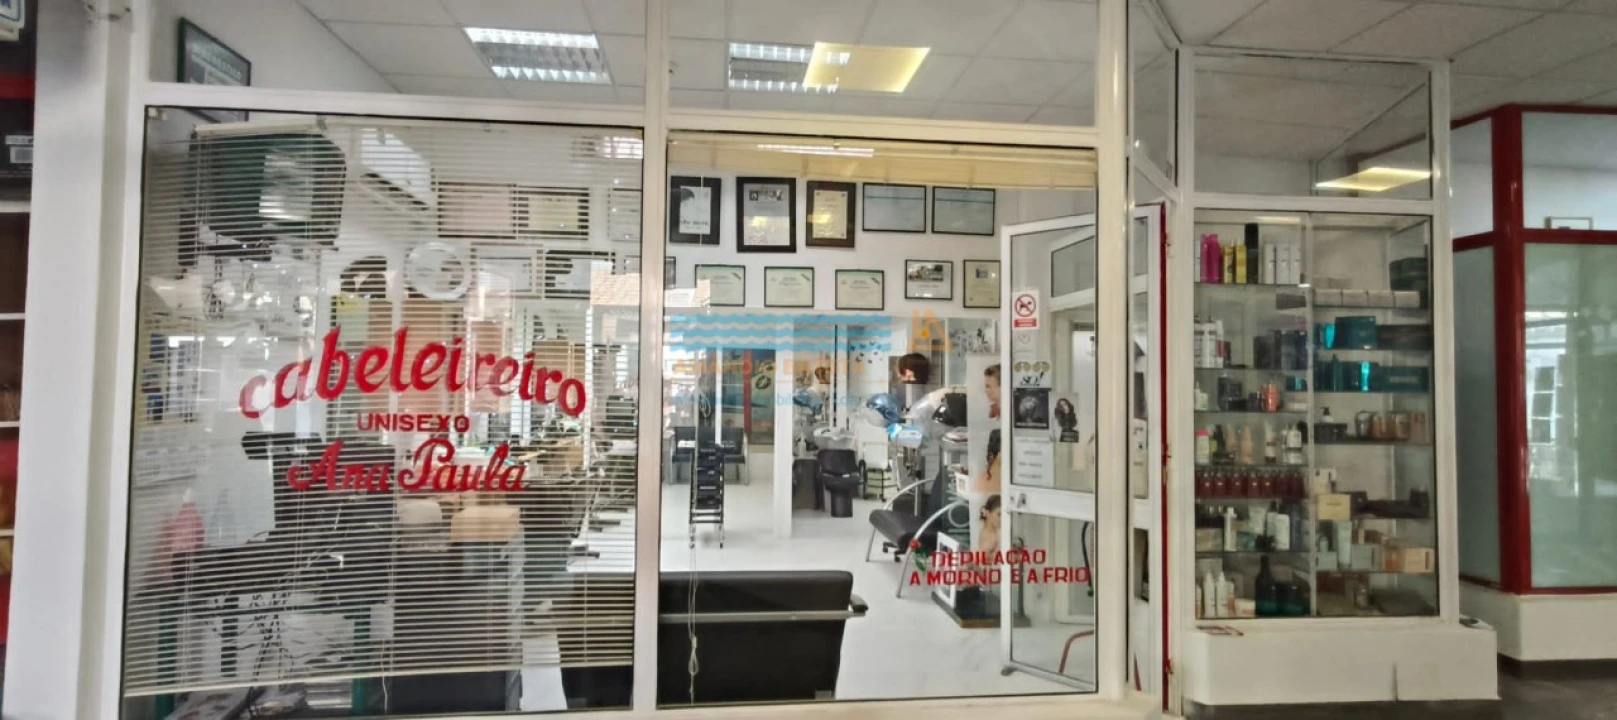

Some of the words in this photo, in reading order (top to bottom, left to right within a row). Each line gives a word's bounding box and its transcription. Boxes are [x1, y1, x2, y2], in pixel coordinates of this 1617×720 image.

[239, 323, 588, 419] cabeleireiro
[357, 413, 470, 432] UNISEXO
[286, 439, 391, 493] Ana
[397, 437, 527, 493] Paula
[909, 571, 921, 586] A
[926, 568, 1002, 586] MORNO
[1010, 568, 1023, 584] E
[1027, 568, 1039, 584] A
[1042, 566, 1090, 583] FRIO
